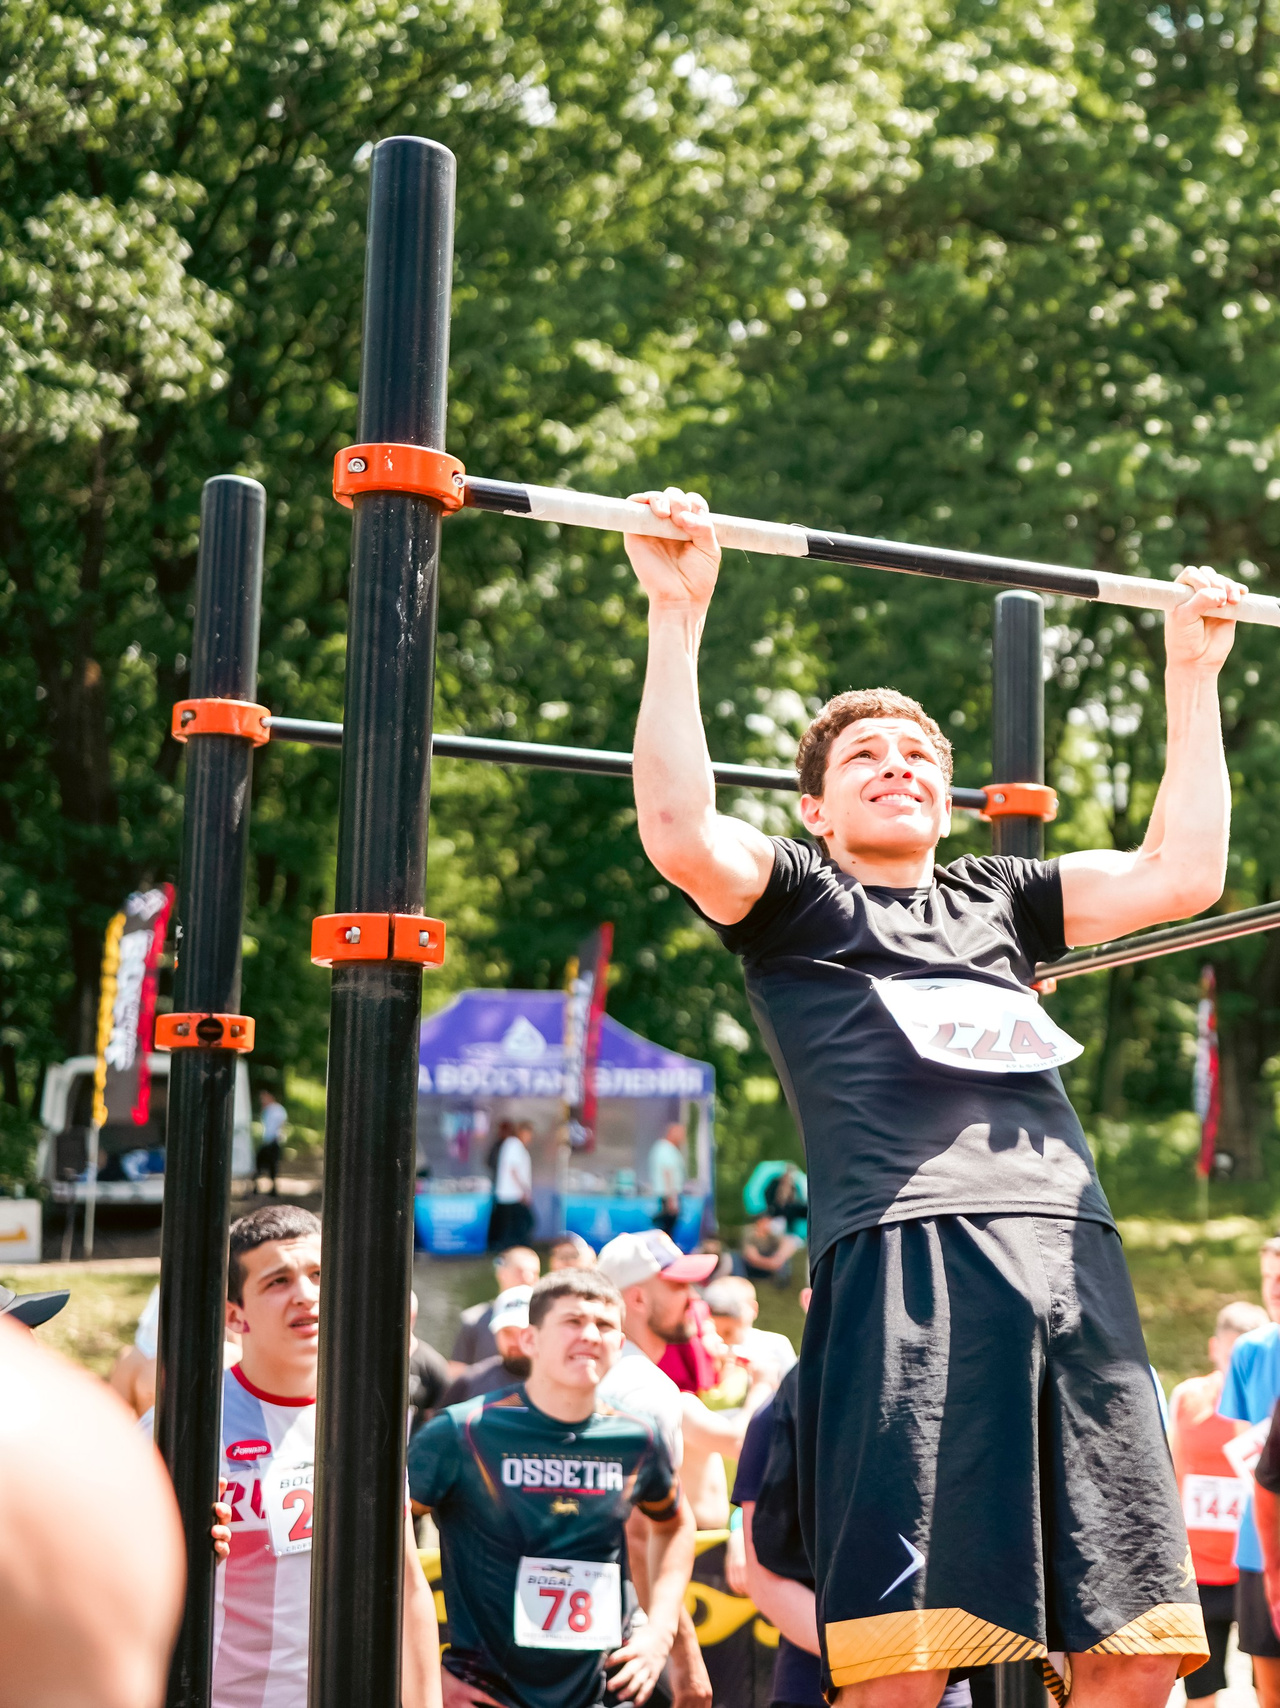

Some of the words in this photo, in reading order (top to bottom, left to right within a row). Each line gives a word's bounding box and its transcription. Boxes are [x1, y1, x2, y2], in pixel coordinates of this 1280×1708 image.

[502, 1458, 623, 1491] OSSETIA
[1193, 1497, 1239, 1519] 144
[539, 1588, 593, 1633] 78
